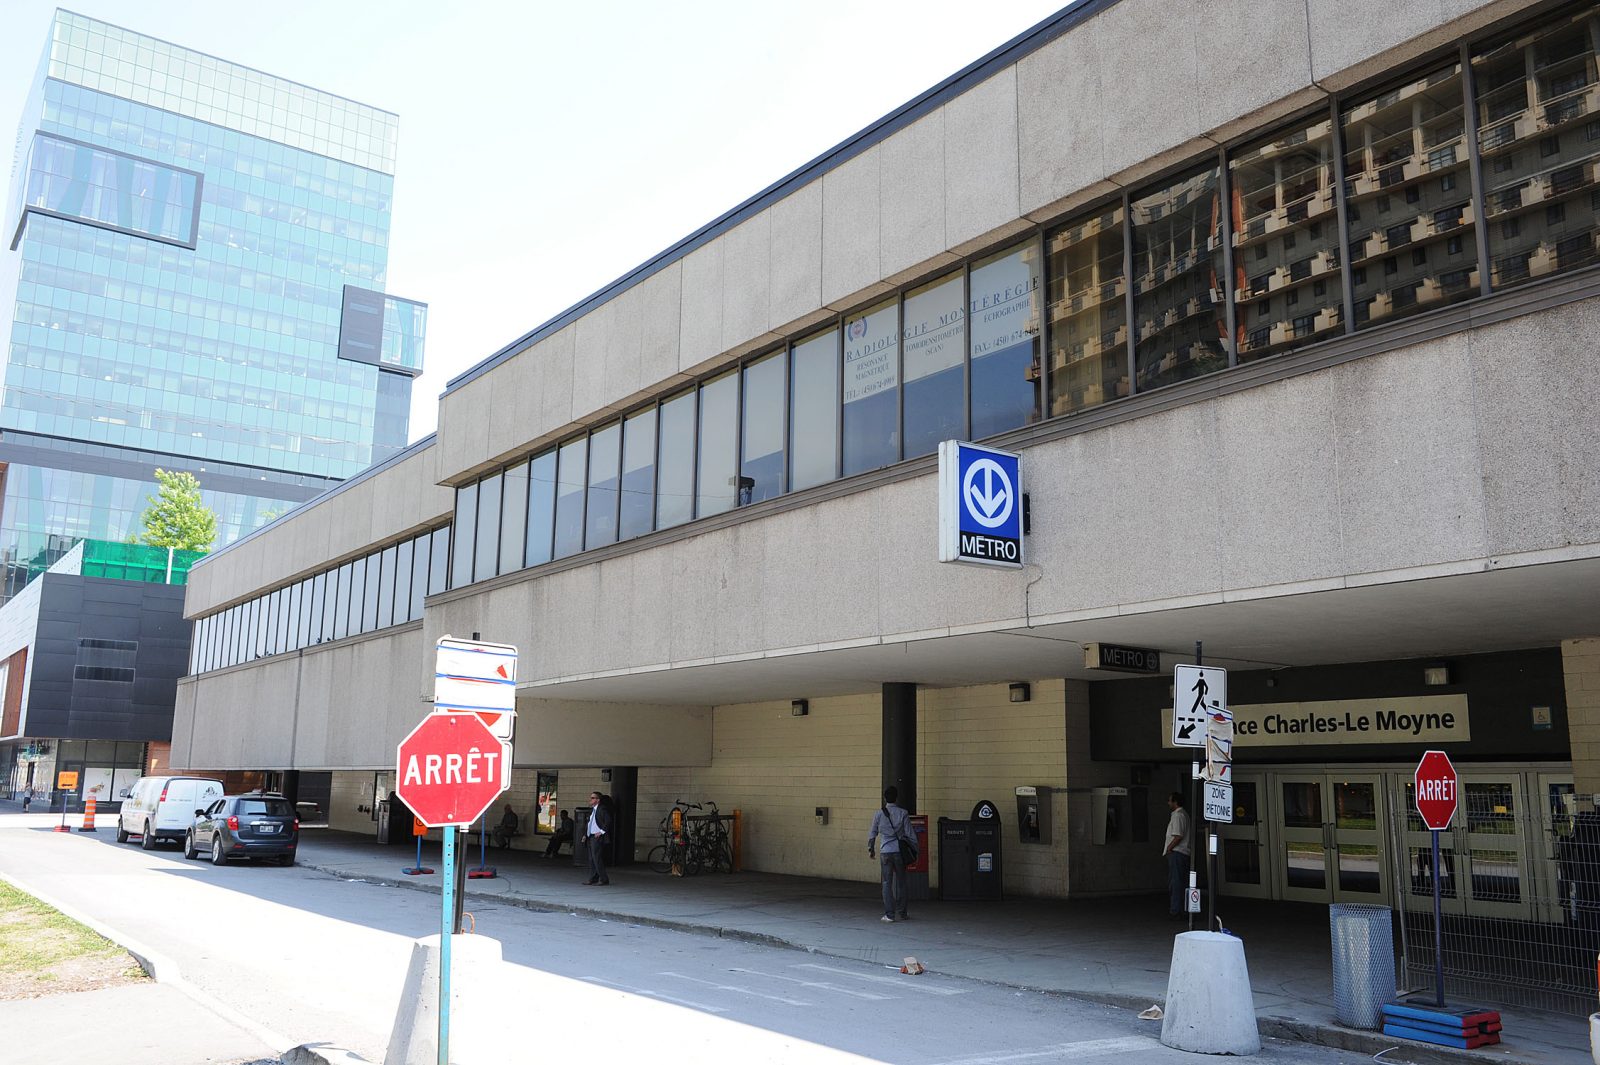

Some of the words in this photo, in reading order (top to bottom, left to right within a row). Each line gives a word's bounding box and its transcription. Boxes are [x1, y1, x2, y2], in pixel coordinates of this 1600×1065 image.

[1263, 711, 1370, 735] Charles-Le
[1376, 710, 1455, 736] Moyne
[403, 747, 498, 786] ARRÊT
[1211, 787, 1226, 800] ZONE
[1418, 775, 1455, 801] ARRÊT
[1206, 801, 1231, 817] PIÉTONNE
